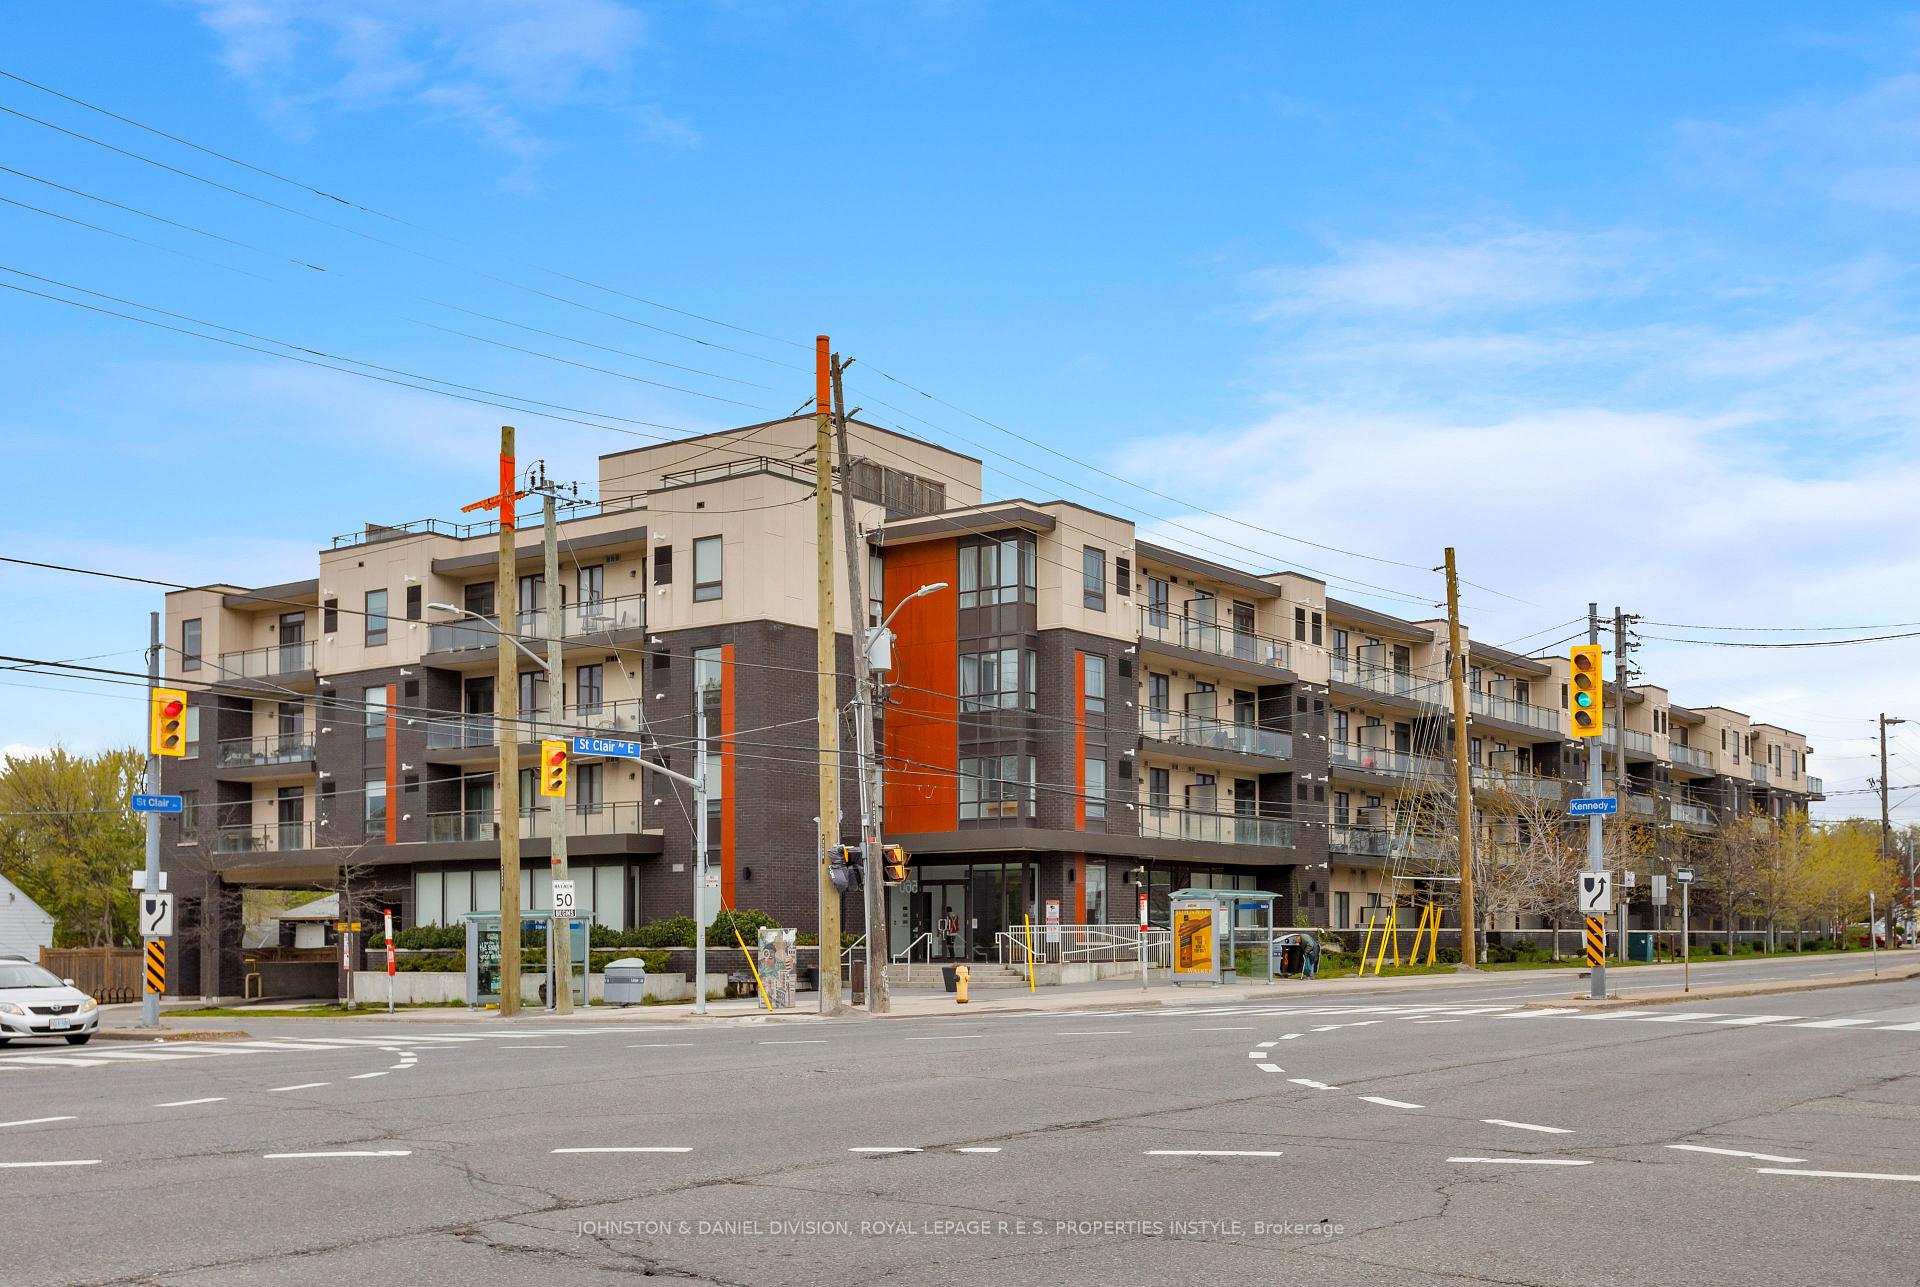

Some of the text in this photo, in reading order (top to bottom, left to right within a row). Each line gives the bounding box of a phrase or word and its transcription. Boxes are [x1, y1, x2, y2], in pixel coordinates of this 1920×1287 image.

[579, 738, 589, 750] St
[593, 739, 616, 753] Clair
[627, 743, 635, 754] E
[136, 797, 147, 807] St
[148, 798, 170, 808] Clair
[1571, 801, 1609, 811] Kennedy
[556, 893, 573, 907] 50
[555, 909, 575, 917] BEGINS
